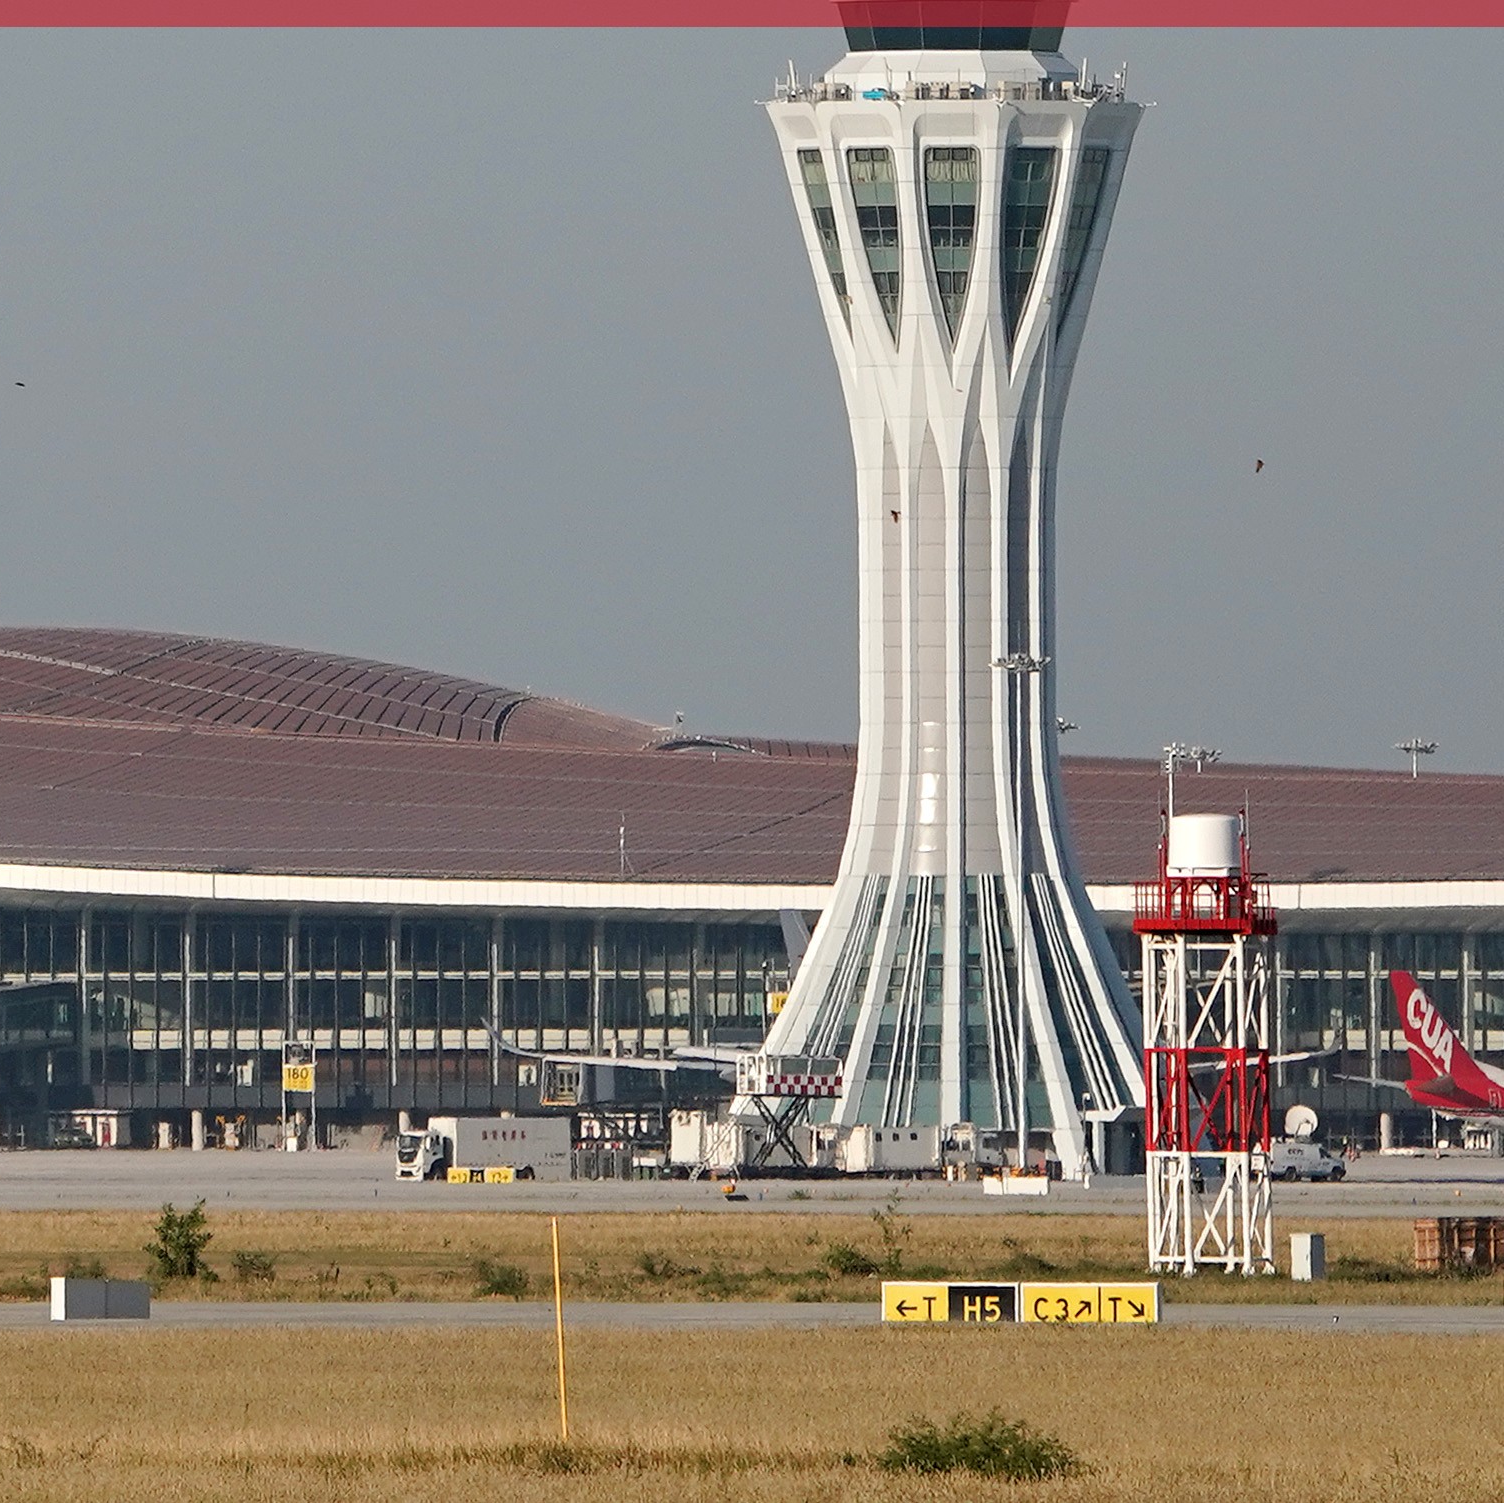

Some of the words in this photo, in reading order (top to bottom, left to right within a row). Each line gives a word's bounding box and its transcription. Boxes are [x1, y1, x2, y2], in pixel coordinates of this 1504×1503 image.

[1406, 988, 1454, 1075] CUA
[287, 1067, 309, 1080] 180
[923, 1297, 937, 1321] T
[963, 1296, 1002, 1322] H5
[1033, 1298, 1069, 1320] C3
[1108, 1297, 1122, 1322] T
